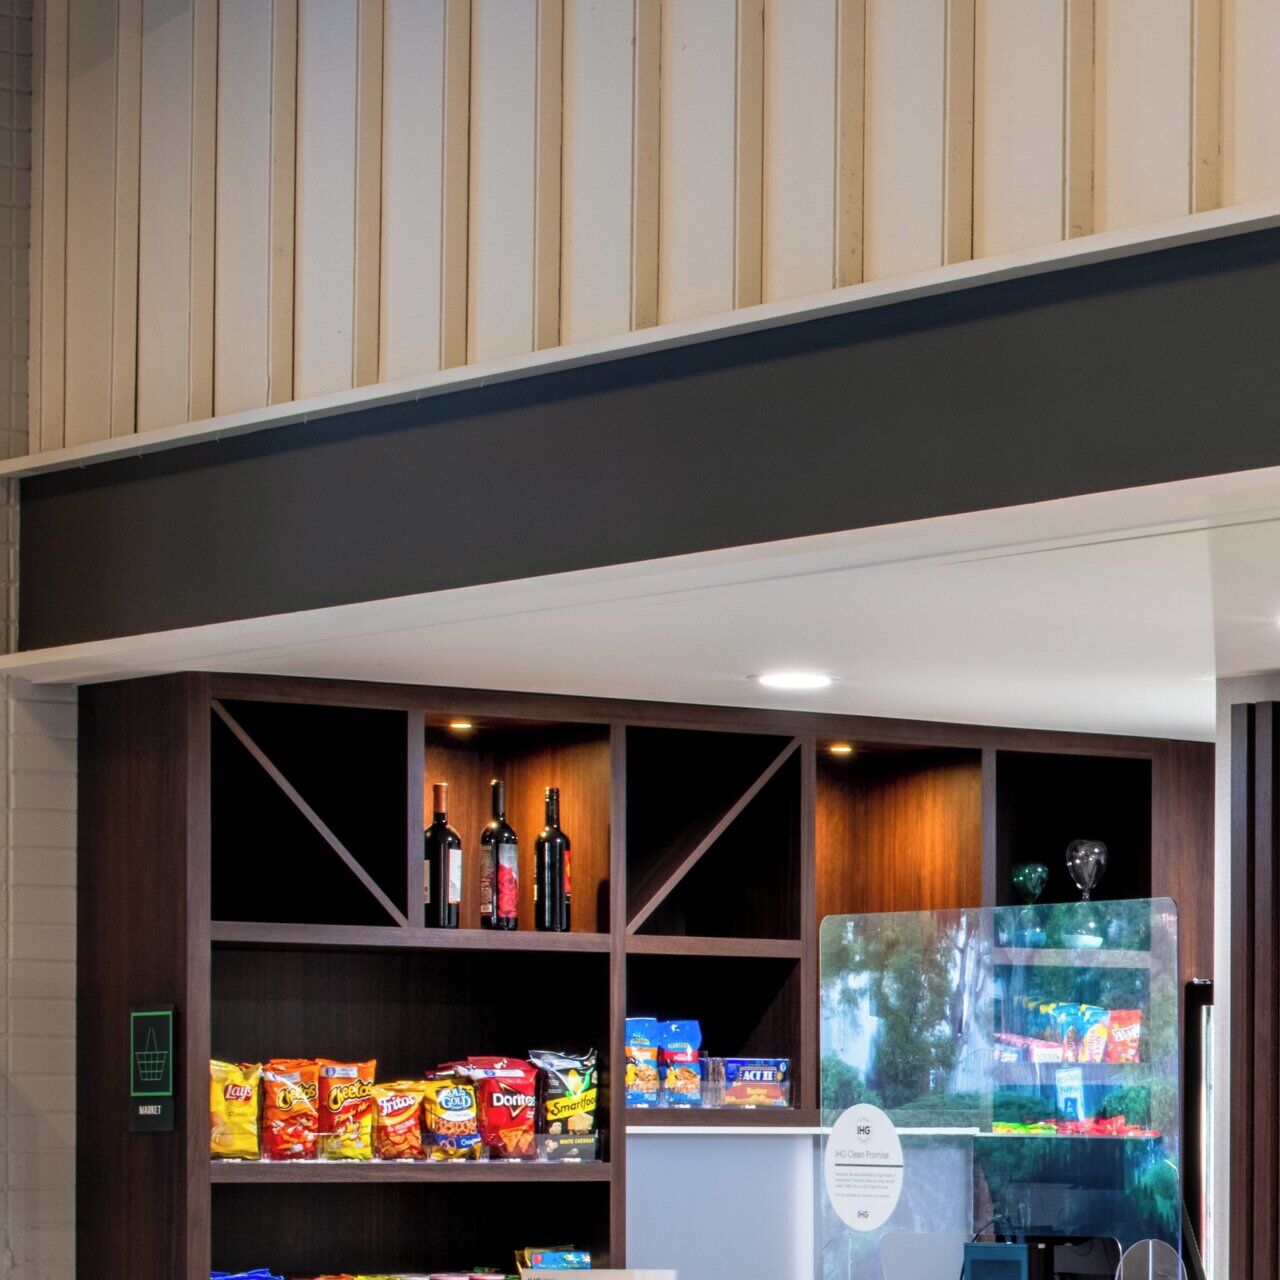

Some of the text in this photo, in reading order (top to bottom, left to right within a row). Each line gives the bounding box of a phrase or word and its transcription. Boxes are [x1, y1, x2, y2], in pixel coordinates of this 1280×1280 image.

[743, 1071, 773, 1080] ACT II
[379, 1094, 415, 1116] Fritos
[441, 1096, 472, 1108] GOLD
[139, 1105, 161, 1115] MARKET
[857, 1126, 871, 1135] IHG
